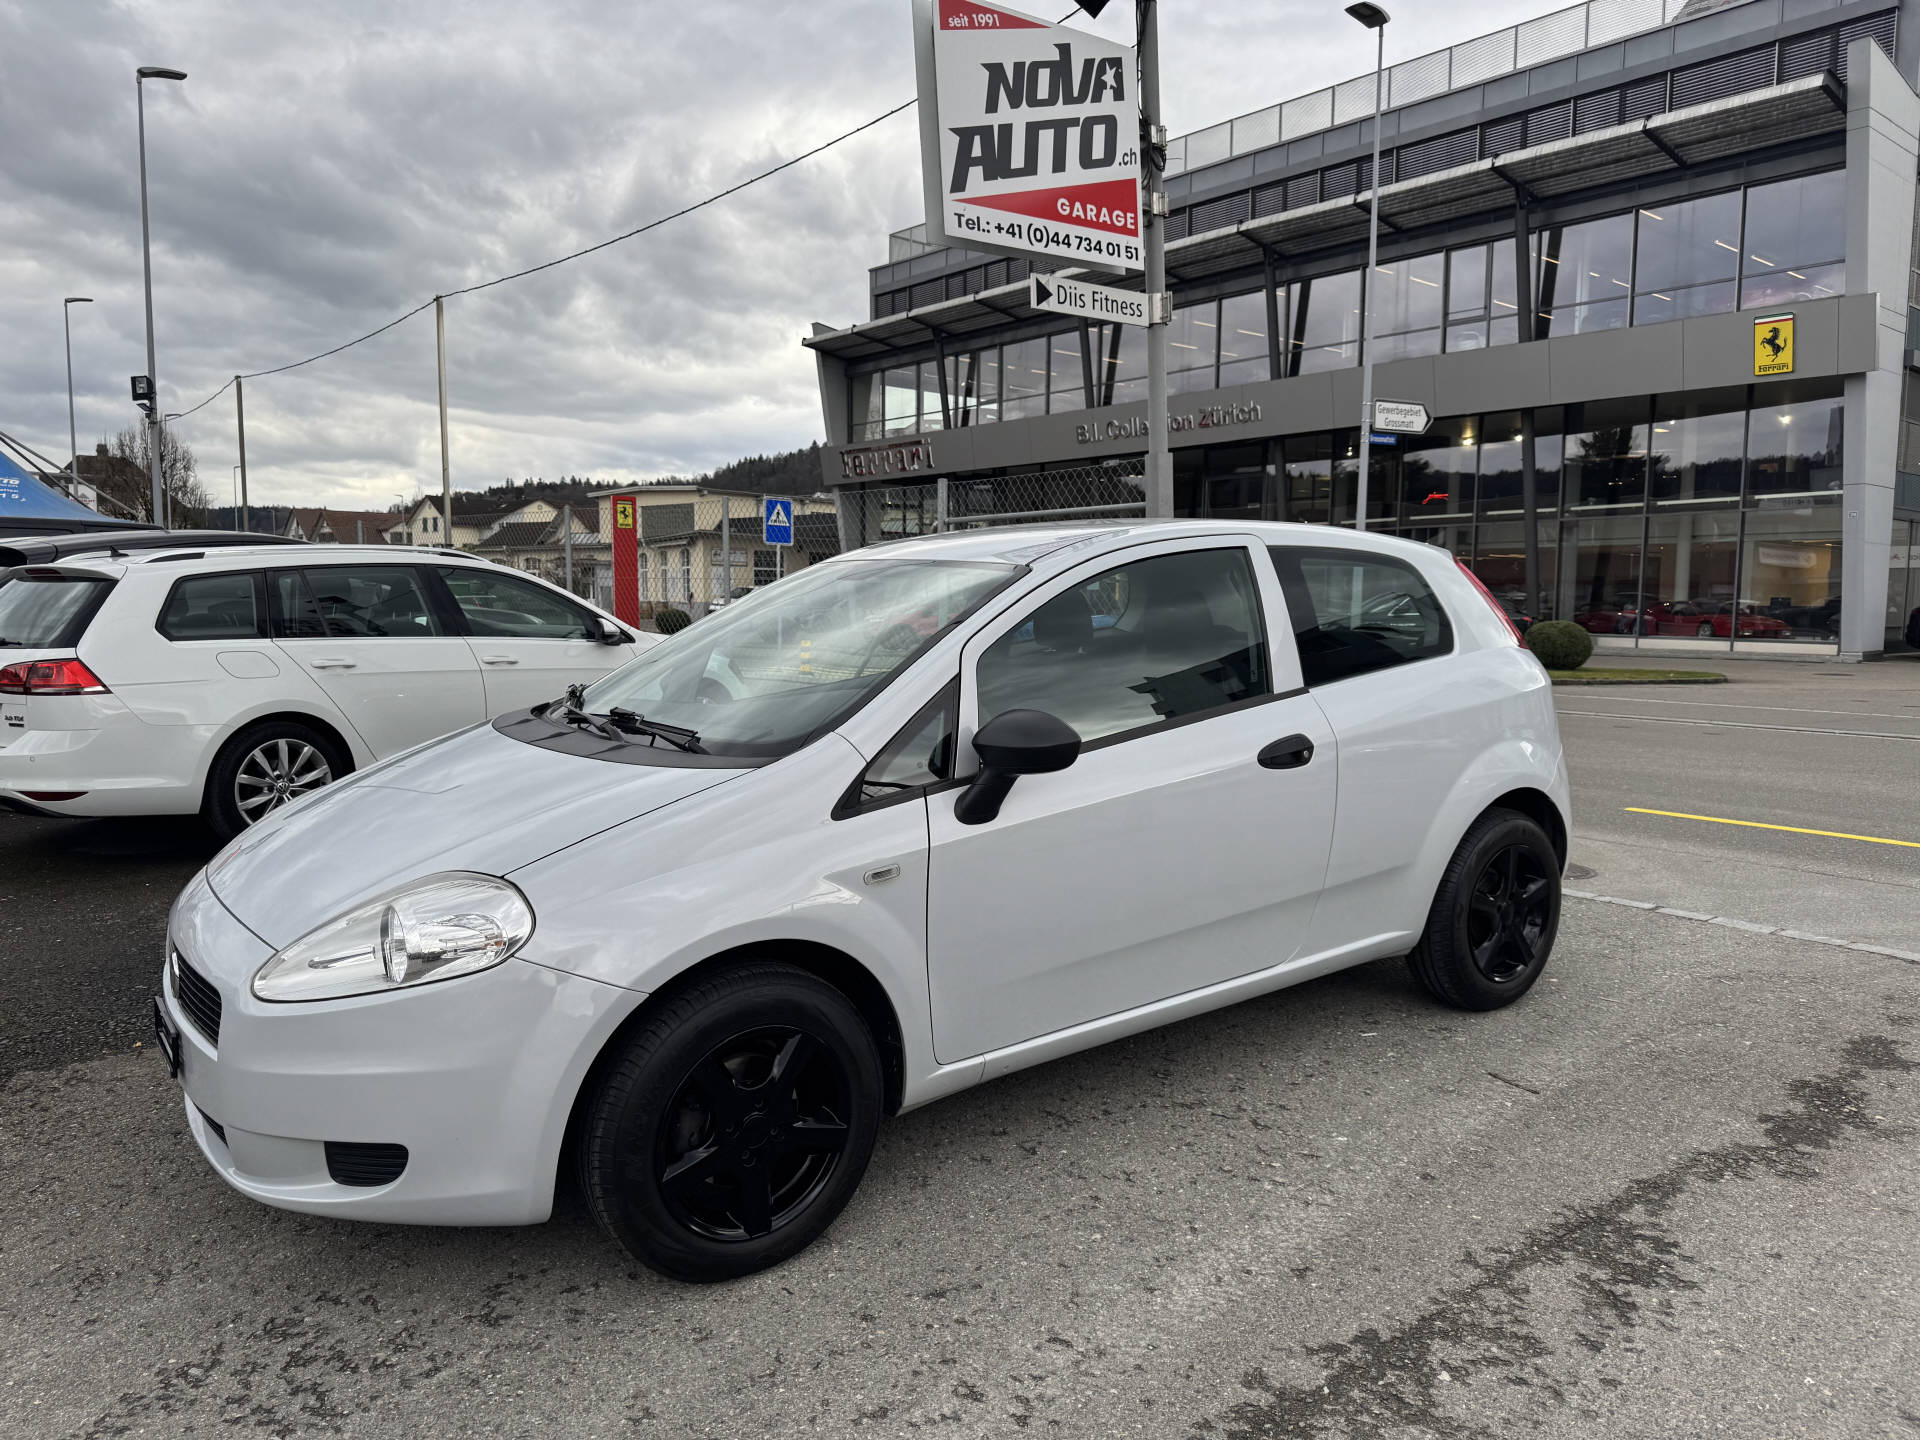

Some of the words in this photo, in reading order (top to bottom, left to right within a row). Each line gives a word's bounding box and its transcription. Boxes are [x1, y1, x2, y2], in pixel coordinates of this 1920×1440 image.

[948, 14, 969, 27] seit
[972, 14, 1000, 27] 1991
[980, 42, 1125, 115] NOVA
[1056, 198, 1136, 230] GARAGE
[954, 212, 991, 234] Tel.:
[994, 223, 1023, 240] +41
[1074, 235, 1103, 255] 734
[1106, 243, 1121, 258] 01
[1124, 247, 1139, 261] 51
[1056, 284, 1087, 309] Diis
[1092, 290, 1144, 318] Fitness
[1758, 362, 1789, 373] Ferrari
[1106, 411, 1194, 440] Colleion
[1198, 400, 1262, 429] Zürich
[1378, 404, 1421, 417] Gewerbegebiet
[839, 437, 935, 479] Ferrari
